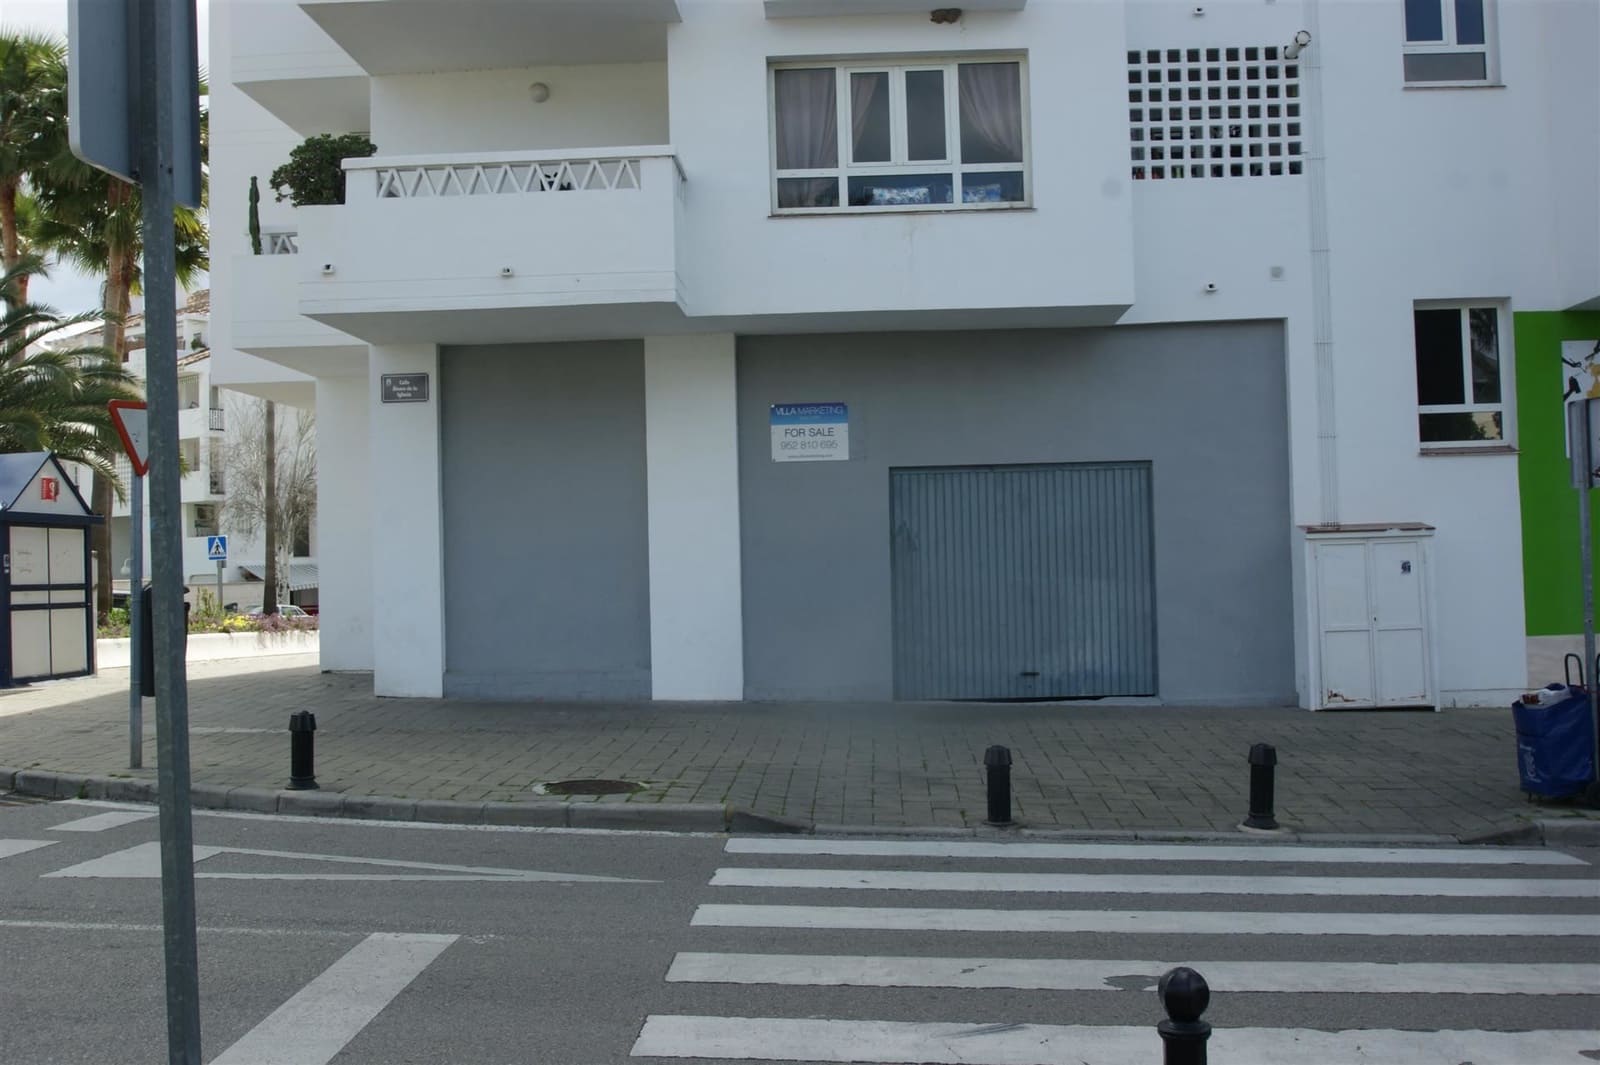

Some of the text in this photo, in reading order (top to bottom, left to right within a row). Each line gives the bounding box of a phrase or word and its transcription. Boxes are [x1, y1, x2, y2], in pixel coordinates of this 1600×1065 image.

[775, 406, 844, 416] VILLA MARKETING
[784, 427, 835, 438] FOR SALE
[780, 441, 799, 450] 952
[800, 440, 818, 450] 810
